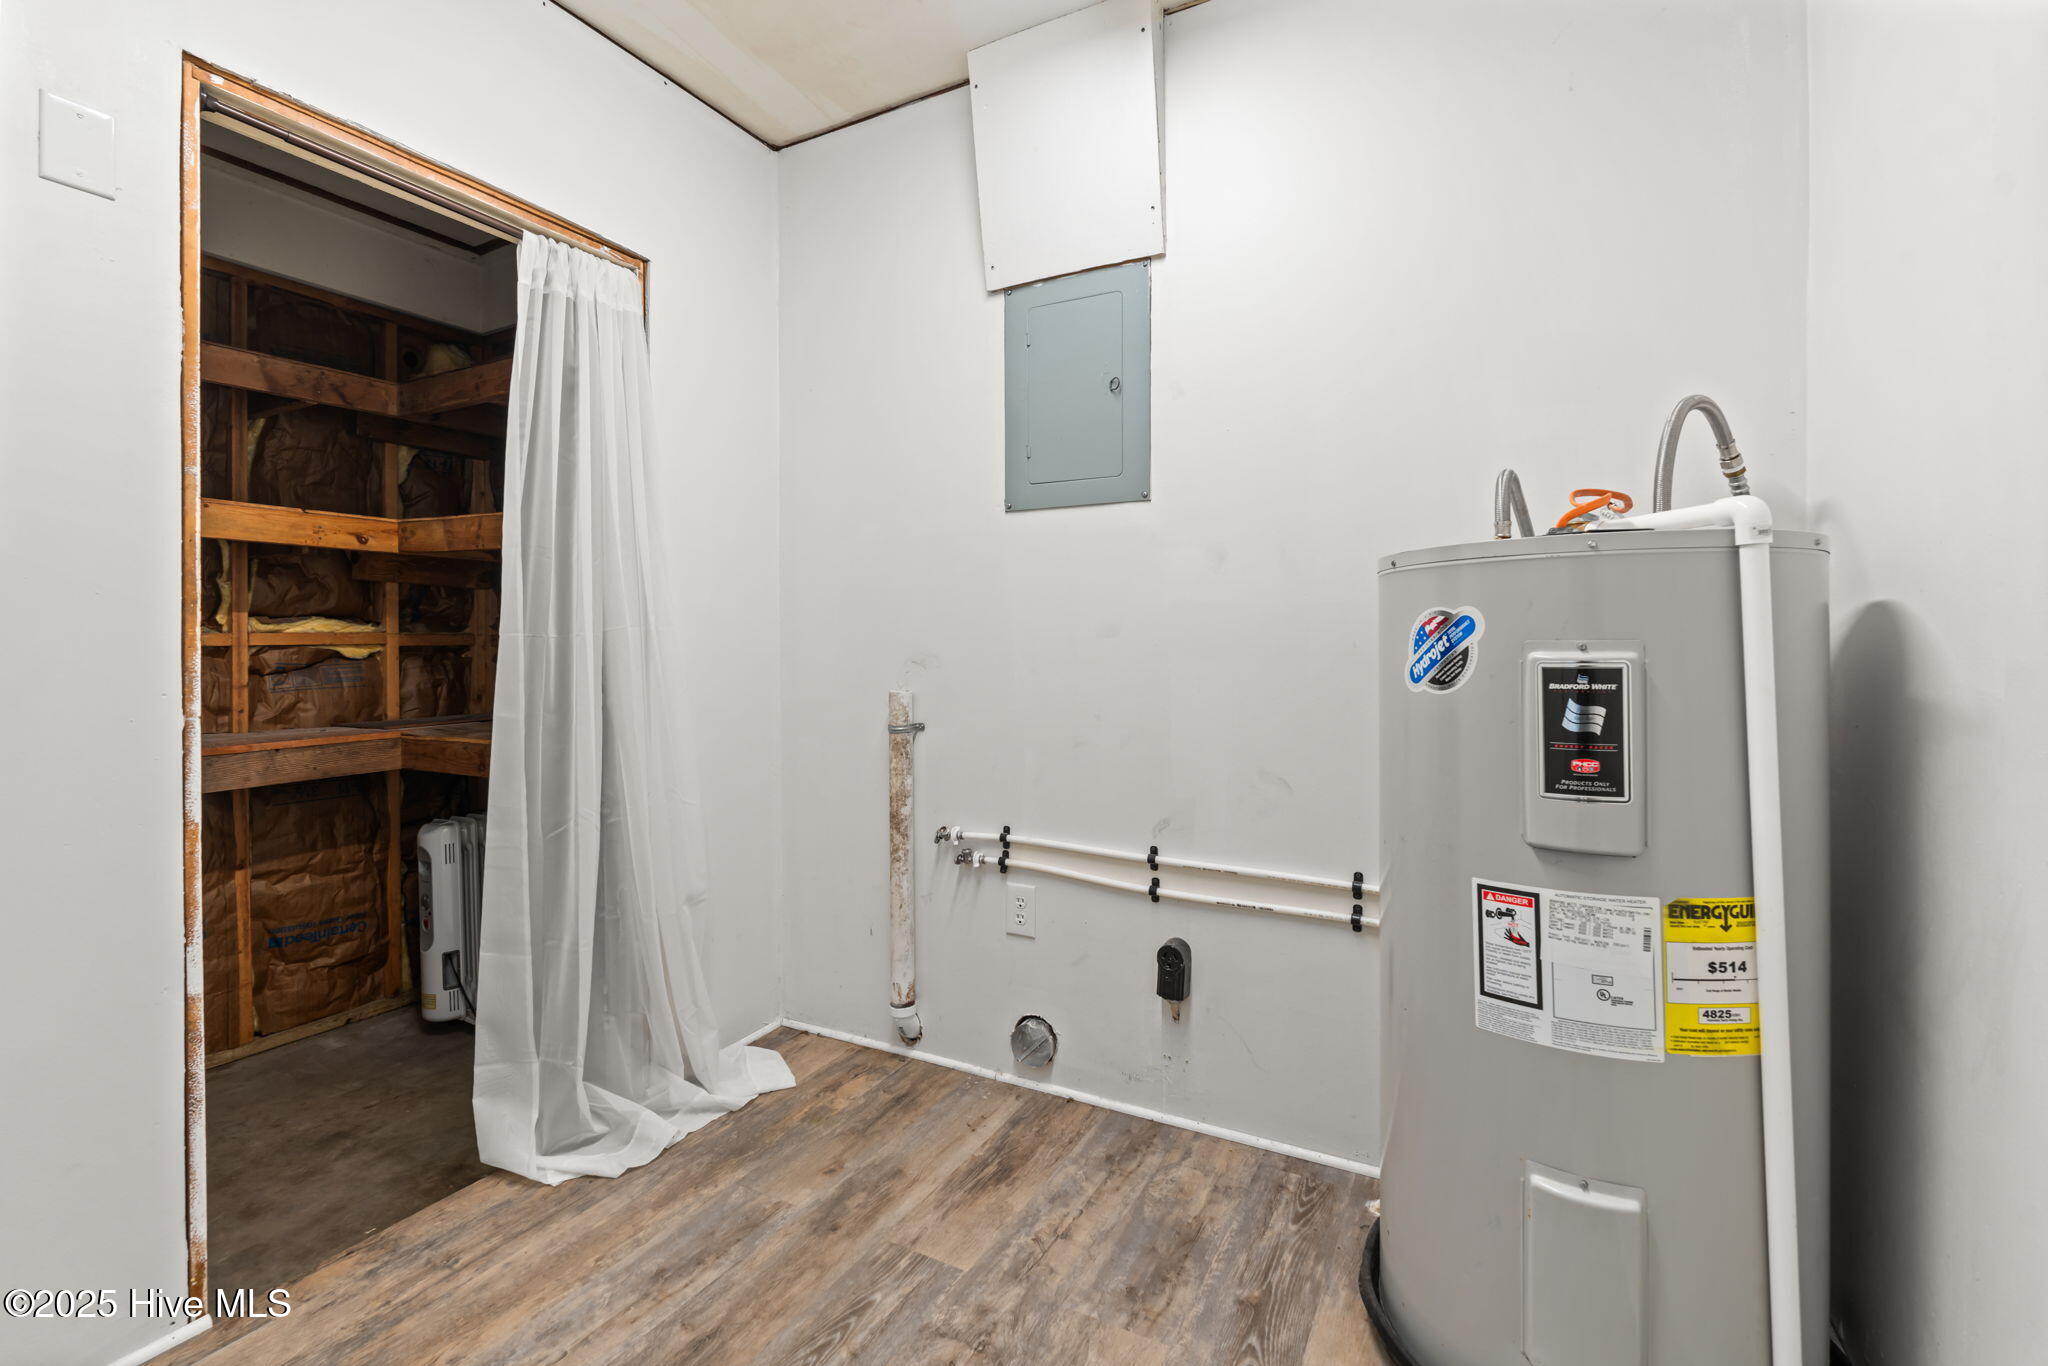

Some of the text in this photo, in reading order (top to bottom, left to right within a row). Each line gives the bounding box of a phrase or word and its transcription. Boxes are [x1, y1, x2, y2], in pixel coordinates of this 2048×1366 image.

[1412, 635, 1450, 678] Hydrojet
[1495, 894, 1529, 905] DANGER
[1669, 904, 1755, 932] ENERGYGUI
[1708, 961, 1747, 974] $514
[1702, 1010, 1732, 1019] 4825
